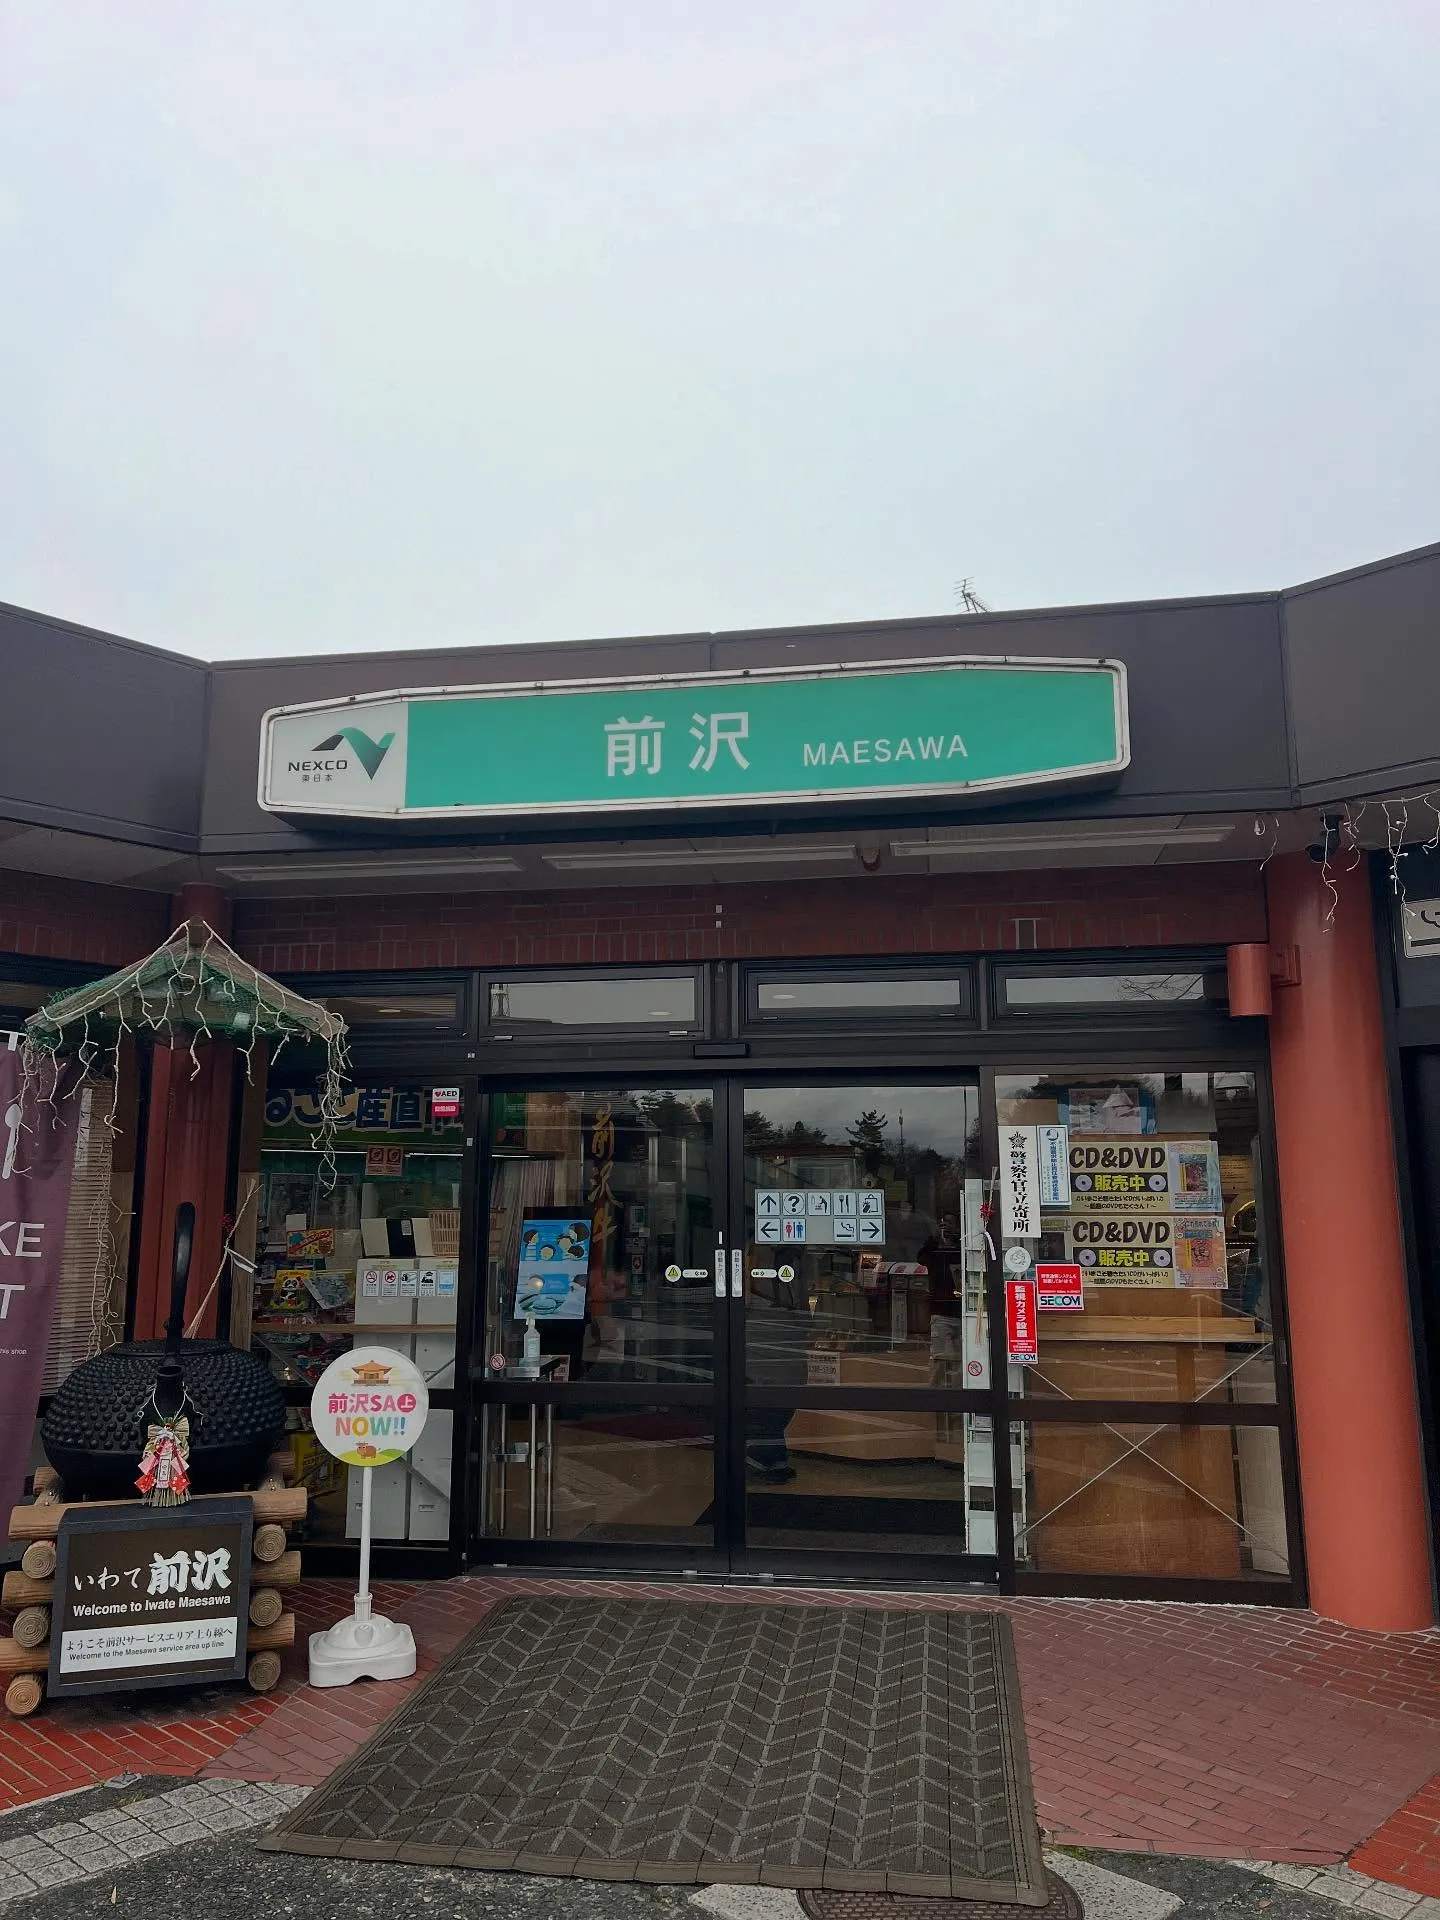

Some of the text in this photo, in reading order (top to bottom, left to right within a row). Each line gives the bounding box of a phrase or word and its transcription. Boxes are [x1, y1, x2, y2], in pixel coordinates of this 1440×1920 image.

[604, 711, 969, 777] 前沢 MAESAWA
[288, 760, 348, 772] NEXCO
[1069, 1147, 1166, 1169] CD&DVD
[1010, 1150, 1030, 1233] 警察官立寄所
[1094, 1174, 1146, 1192] 販売中
[1073, 1221, 1171, 1244] CD&DVD
[1098, 1249, 1150, 1267] 販売中
[1014, 1285, 1028, 1338] 監視カメラ設置
[1040, 1296, 1080, 1306] SECOM
[335, 1416, 406, 1437] NOW!!
[73, 1595, 231, 1617] Welcome to Iwate Maesawa
[66, 1627, 233, 1651] ようこそ前沢サービスエリア上り線へ
[69, 1652, 101, 1661] Welcome
[125, 1647, 157, 1656] Maesawa
[158, 1644, 184, 1653] service
[184, 1643, 200, 1651] area
[201, 1642, 211, 1651] up
[211, 1640, 225, 1649] line
